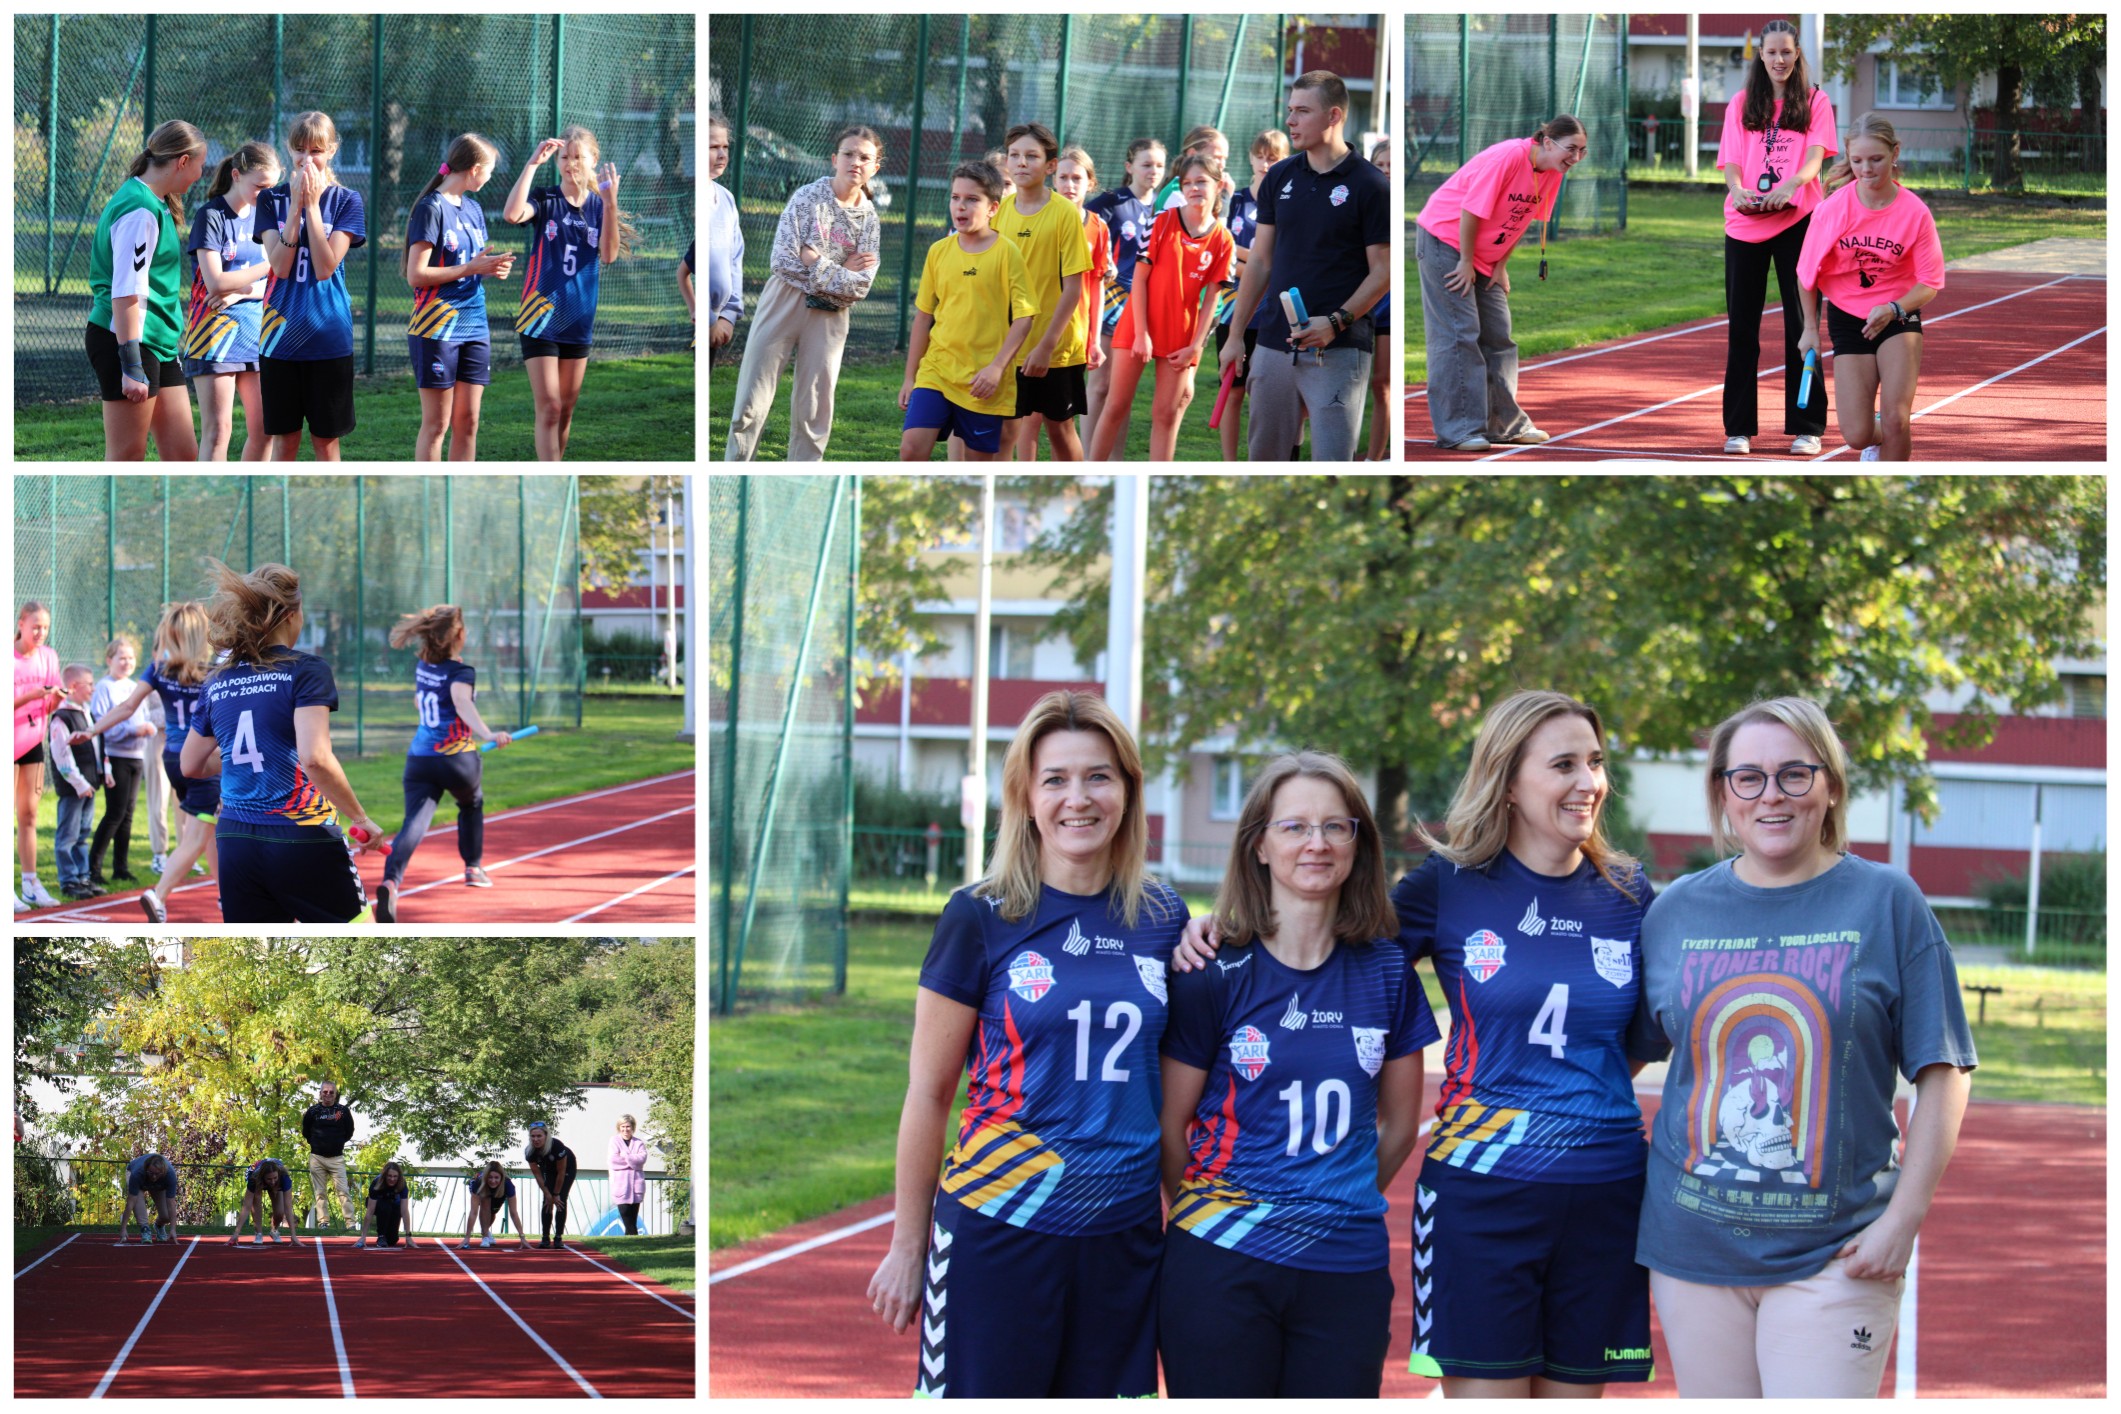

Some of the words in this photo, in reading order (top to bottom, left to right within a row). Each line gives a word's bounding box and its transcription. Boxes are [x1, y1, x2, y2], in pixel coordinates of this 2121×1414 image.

[1840, 236, 1904, 256] NAJLEPSI
[296, 247, 309, 282] 6
[562, 244, 578, 276] 5
[1197, 250, 1212, 271] 9
[220, 690, 229, 699] 17
[240, 684, 277, 696] ŻORACH
[229, 672, 292, 687] PODSTAWOWA
[416, 690, 440, 728] 10
[231, 709, 264, 773] 4
[1550, 916, 1583, 932] ŻORY
[1094, 935, 1124, 950] ŻORY
[1682, 938, 1717, 950] EVERY
[1718, 937, 1758, 949] FRIDAY
[1780, 935, 1806, 947] YOUR
[1807, 932, 1838, 945] LOCAL
[1681, 950, 1779, 1010] STONER
[1783, 944, 1851, 1014] ROCK
[1311, 1009, 1343, 1023] ŻORY
[1528, 983, 1569, 1059] 4
[1067, 1000, 1143, 1082] 12
[1279, 1079, 1350, 1157] 10
